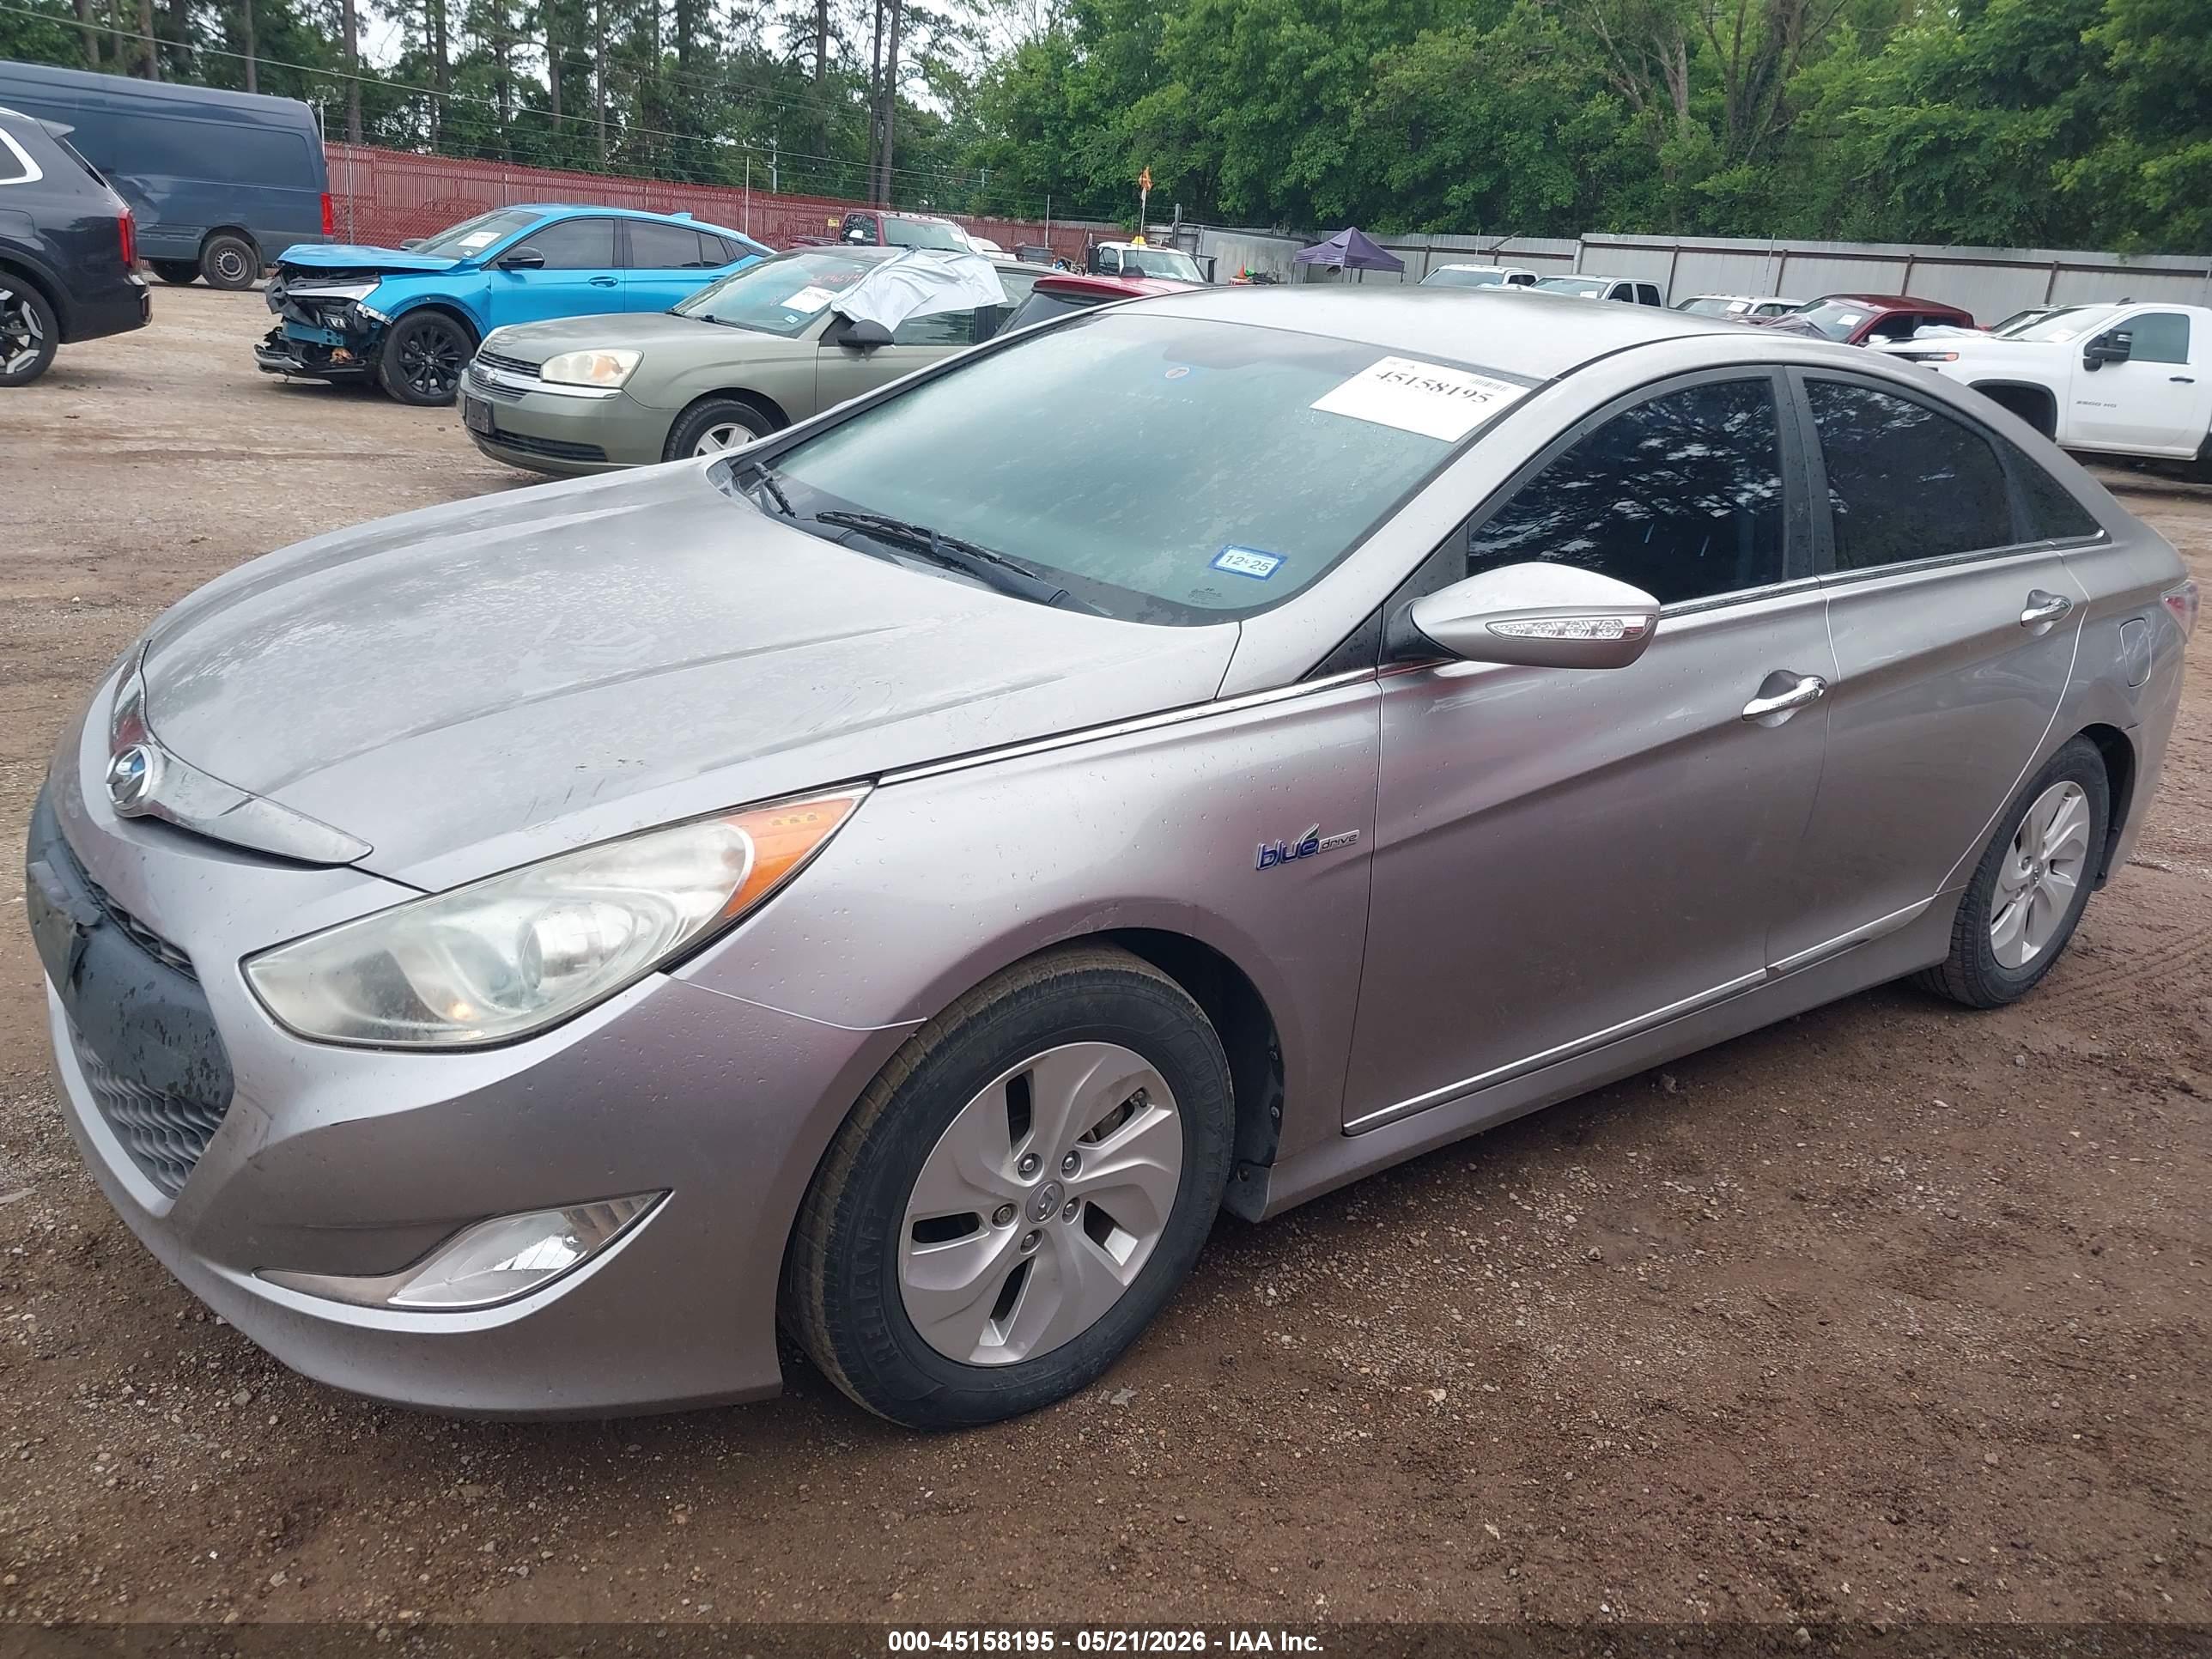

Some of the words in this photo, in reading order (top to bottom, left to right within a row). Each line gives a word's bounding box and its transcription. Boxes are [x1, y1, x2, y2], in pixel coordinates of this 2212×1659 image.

[1376, 370, 1495, 404] 45158195
[1225, 555, 1245, 566] 12
[1249, 560, 1272, 571] 25
[1256, 836, 1320, 870] blue
[1322, 833, 1358, 850] drive
